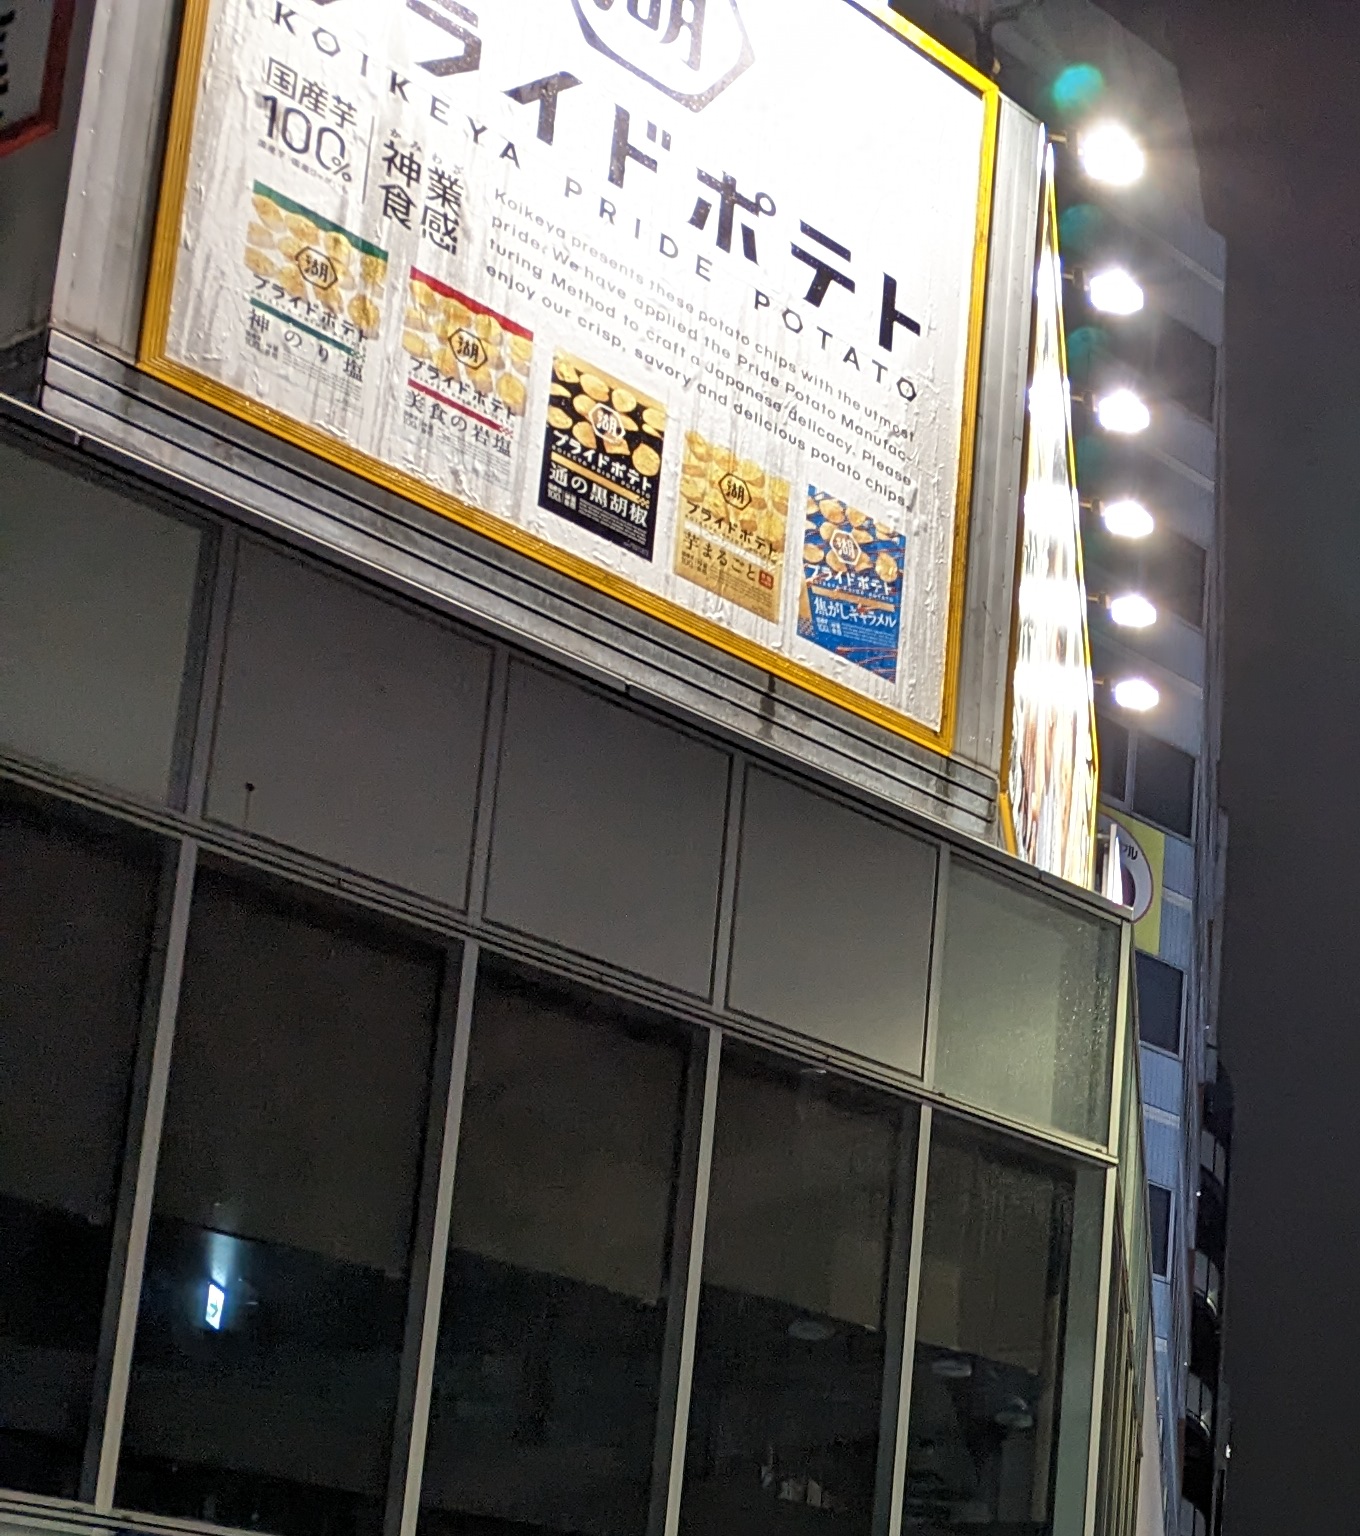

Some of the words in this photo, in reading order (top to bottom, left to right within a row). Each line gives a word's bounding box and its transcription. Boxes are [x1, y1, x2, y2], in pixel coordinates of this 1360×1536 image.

[266, 57, 357, 129] 国産芋
[262, 95, 352, 182] 100%
[275, 2, 520, 169] KOIKEYA
[564, 176, 712, 282] PRIDE
[754, 288, 917, 402] POTATO
[308, 0, 915, 352] ライドポテト
[253, 273, 369, 344] プライドポテト
[495, 188, 566, 239] Koikeya
[571, 236, 644, 285] presents
[649, 279, 694, 314] these
[698, 310, 750, 346] potato
[755, 343, 797, 374] chips
[801, 369, 834, 396] with
[838, 389, 861, 411] the
[864, 407, 914, 442] utmost
[552, 247, 579, 272] We
[584, 266, 626, 300] have
[634, 297, 698, 341] applied
[704, 336, 731, 359] the
[738, 354, 779, 387] Pride
[786, 382, 836, 420] Potato
[248, 308, 364, 383] 神のり塩
[486, 264, 536, 301] enjoy
[542, 295, 572, 319] our
[577, 315, 626, 351] crisp,
[633, 349, 692, 402] savory
[696, 381, 728, 407] and
[733, 403, 806, 450] delicious
[811, 447, 860, 482] potato
[490, 238, 542, 280] turing
[551, 273, 616, 319] Method
[623, 314, 639, 332] to
[646, 329, 688, 357] craft
[690, 354, 700, 366] a
[705, 362, 782, 412] Japanese
[862, 449, 912, 486] Please
[410, 356, 516, 419] プライドポテト
[405, 391, 512, 458] 美食の岩塩
[549, 462, 648, 528] 通の黒胡椒
[552, 430, 653, 492] プライドポテト
[686, 500, 777, 556] プライドポテト
[806, 564, 892, 595] プライドポテト
[814, 596, 897, 628] 焦がしキャラメル
